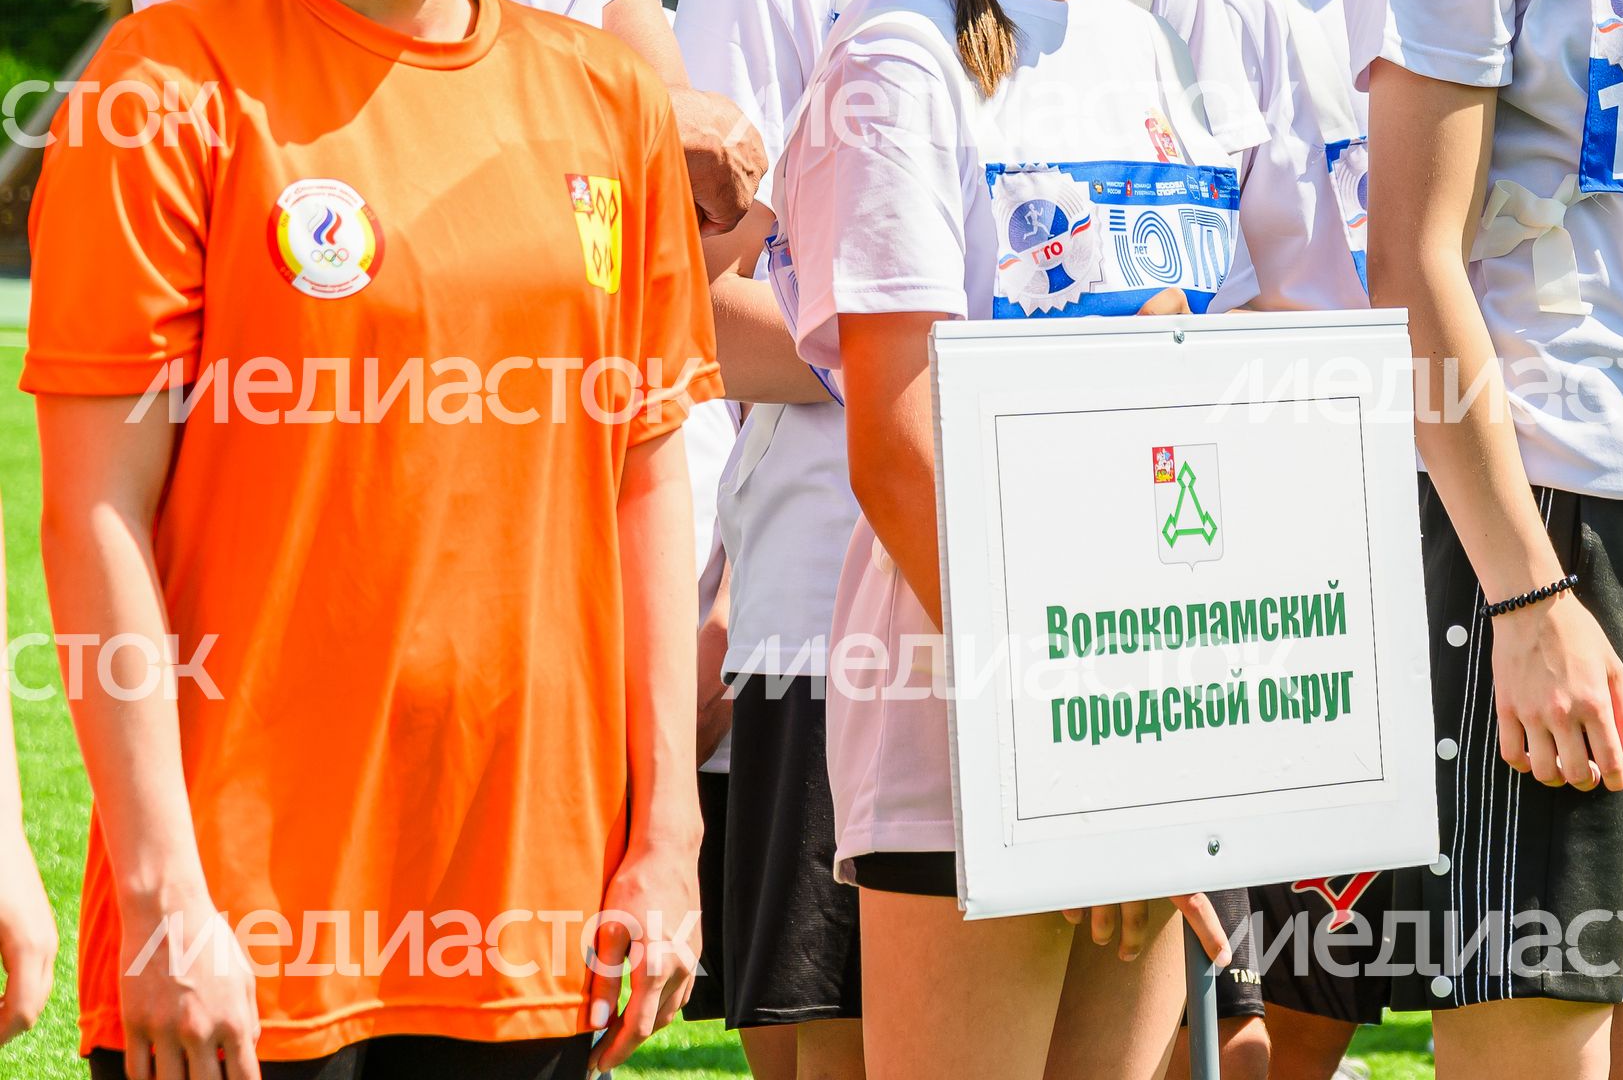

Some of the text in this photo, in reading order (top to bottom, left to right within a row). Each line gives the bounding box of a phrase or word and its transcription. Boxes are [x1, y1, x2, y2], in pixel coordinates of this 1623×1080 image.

[1032, 241, 1063, 265] ГТО
[1046, 579, 1347, 660] Волоколамский
[1051, 667, 1354, 746] городской округ
